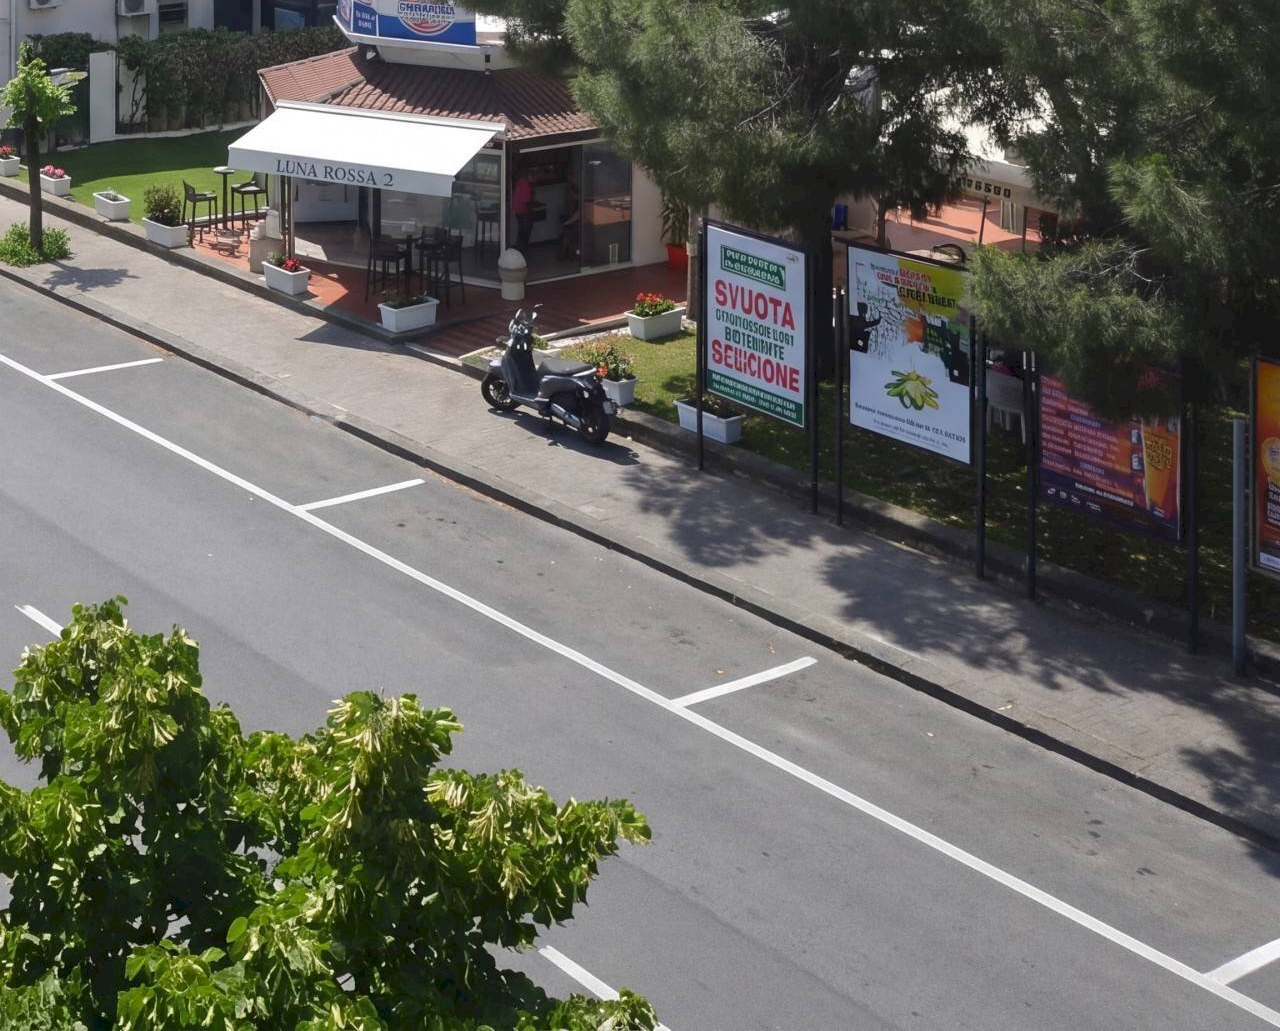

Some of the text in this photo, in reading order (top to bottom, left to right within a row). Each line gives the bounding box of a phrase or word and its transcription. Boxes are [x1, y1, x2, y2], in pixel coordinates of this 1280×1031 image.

[276, 159, 394, 186] LUNA ROSSA 2
[715, 279, 795, 330] SVUOTA
